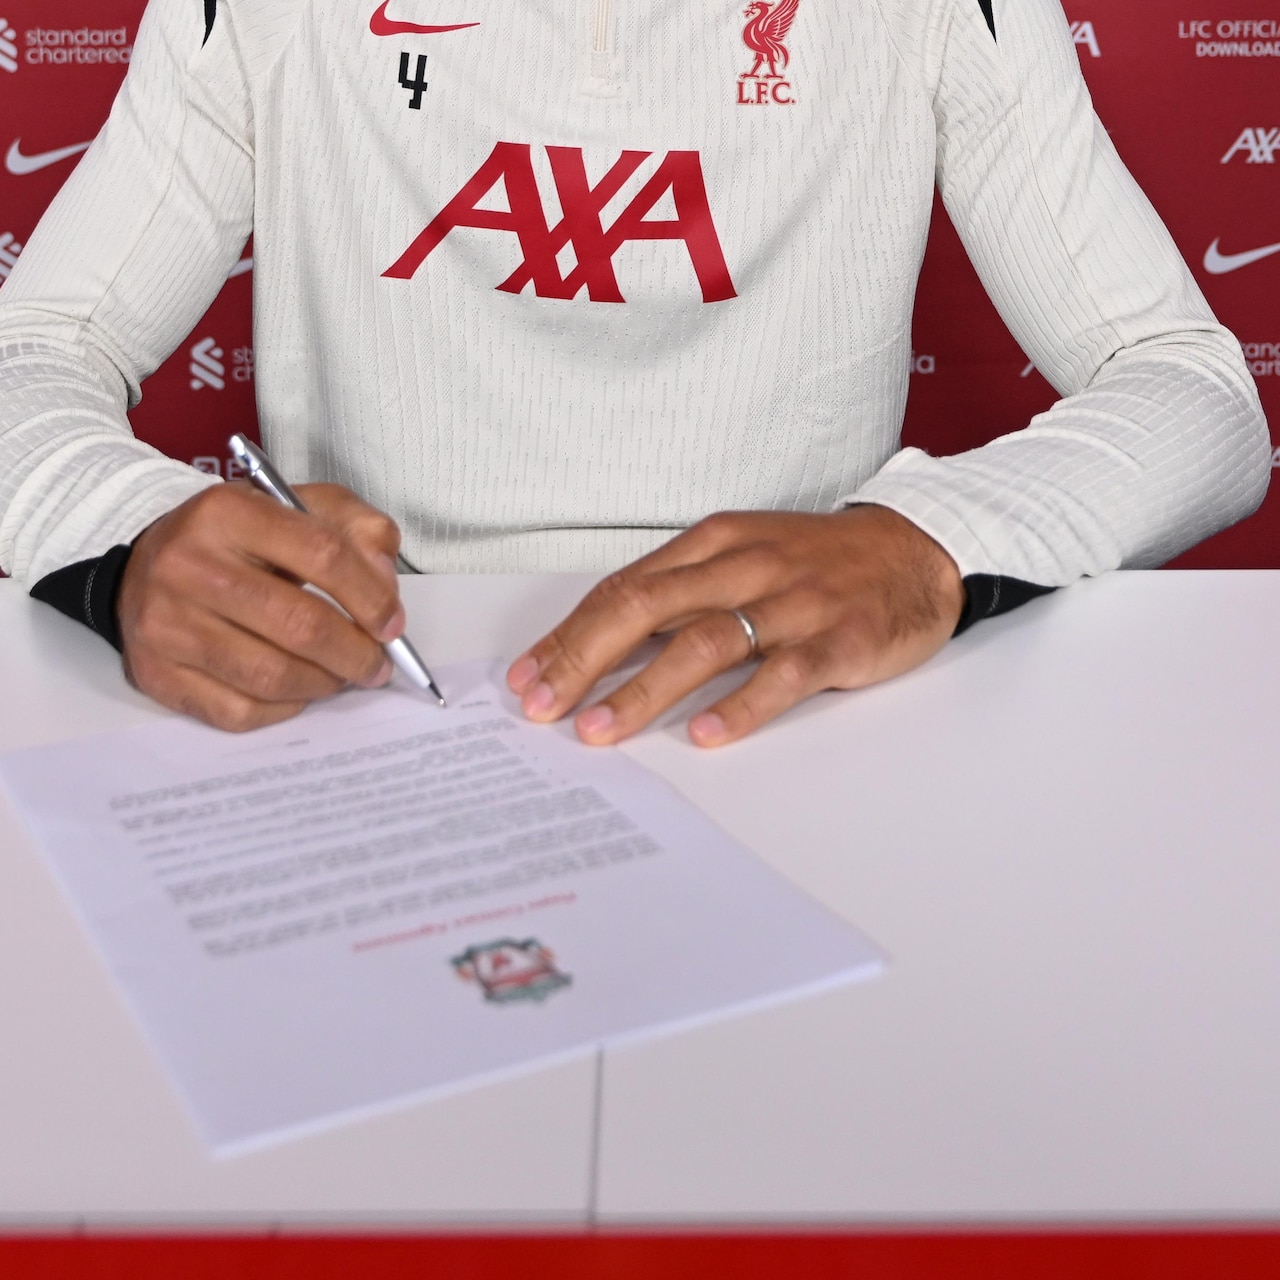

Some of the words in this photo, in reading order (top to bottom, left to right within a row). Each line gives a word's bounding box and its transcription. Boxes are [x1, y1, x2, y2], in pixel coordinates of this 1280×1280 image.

[1178, 20, 1212, 39] LFC
[398, 52, 428, 110] 4
[736, 81, 797, 106] L.F.C.
[380, 141, 738, 303] AXA
